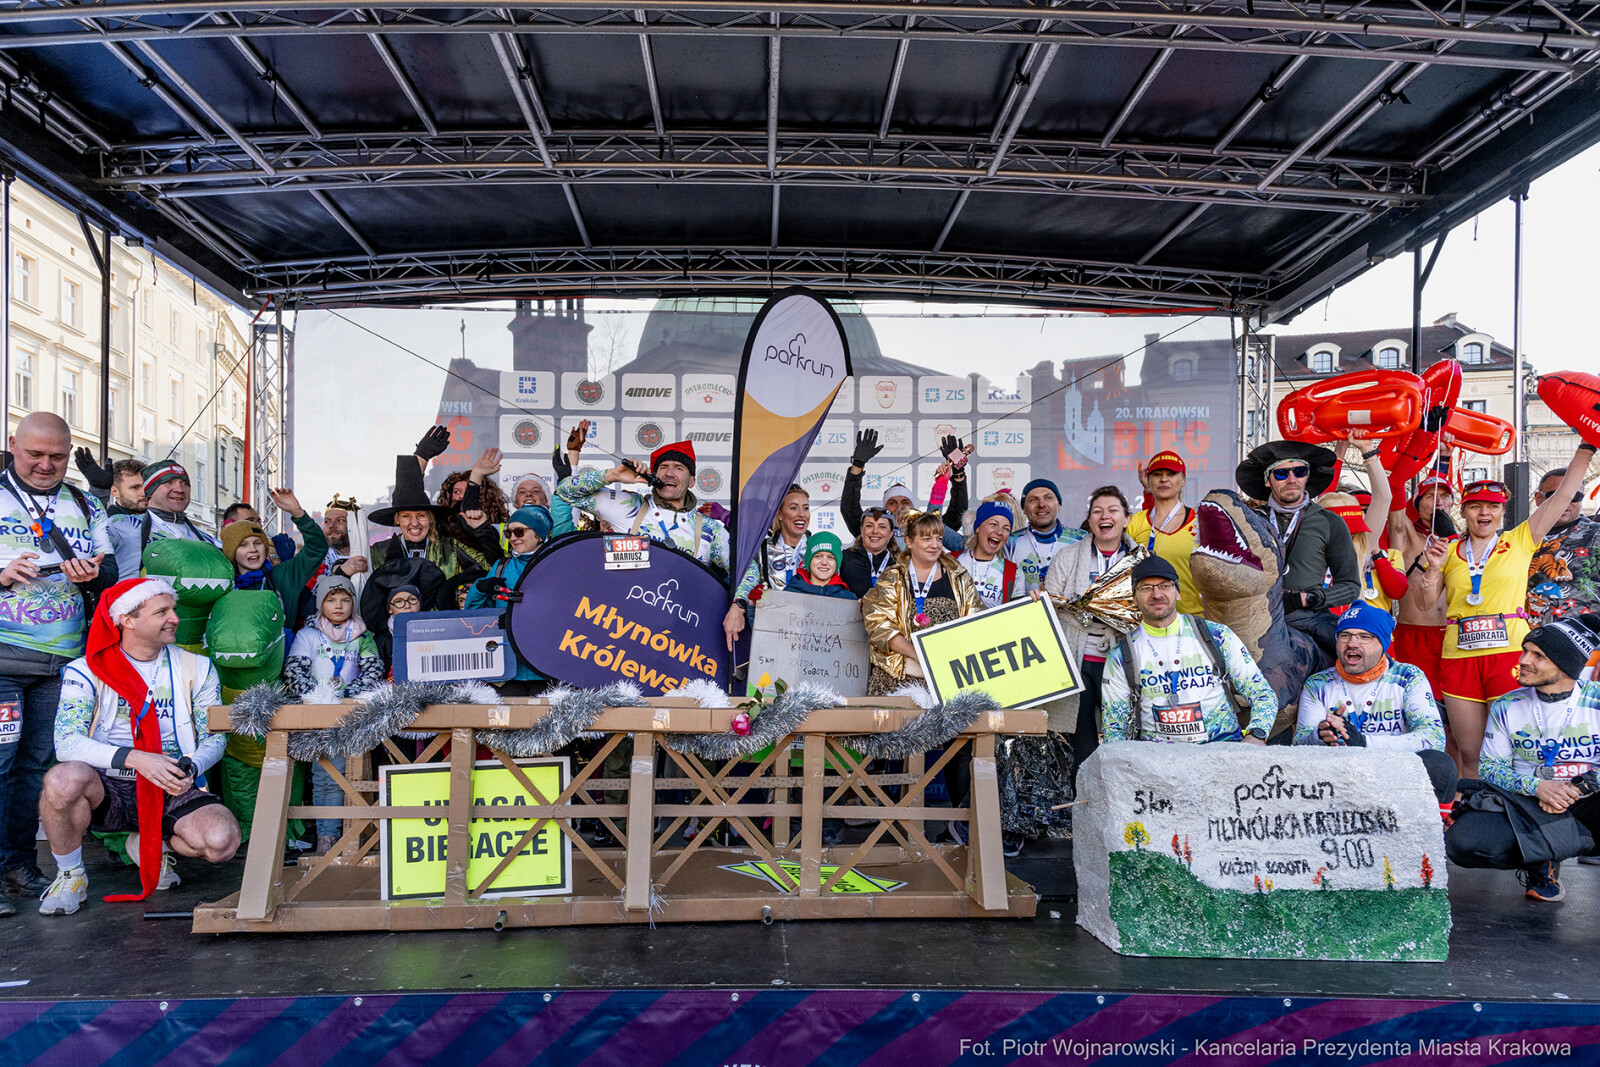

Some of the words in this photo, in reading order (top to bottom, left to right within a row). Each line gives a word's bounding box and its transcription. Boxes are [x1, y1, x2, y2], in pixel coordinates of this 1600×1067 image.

[765, 333, 834, 378] parkrun
[625, 387, 673, 398] 4MOVE
[945, 389, 966, 401] ZIS
[1115, 407, 1134, 419] 20.
[1136, 406, 1210, 419] KRAKOWSKI
[685, 432, 732, 442] 4MOVE
[827, 432, 848, 444] ZIS
[1004, 432, 1025, 444] ZIS
[1114, 421, 1211, 456] BIEG
[803, 472, 845, 484] OSTROMECK
[887, 476, 906, 488] ZIS
[614, 540, 641, 551] 3105
[612, 551, 643, 562] MARIUSZ
[626, 578, 700, 628] parkrun
[1465, 618, 1494, 632] 3821
[573, 595, 719, 678] Młynówka
[1458, 630, 1505, 643] MAŁGORZATA
[948, 636, 1047, 689] META
[803, 667, 830, 678] SOBOTA
[832, 660, 860, 679] 9:00
[1160, 709, 1193, 723] 3927
[1158, 722, 1201, 734] SEBASTIAN
[1553, 764, 1589, 778] 2394
[1233, 765, 1335, 816] parkrun
[406, 829, 548, 864] BIEACZE
[1320, 837, 1375, 871] 9:00
[1264, 858, 1312, 877] SOBOTA
